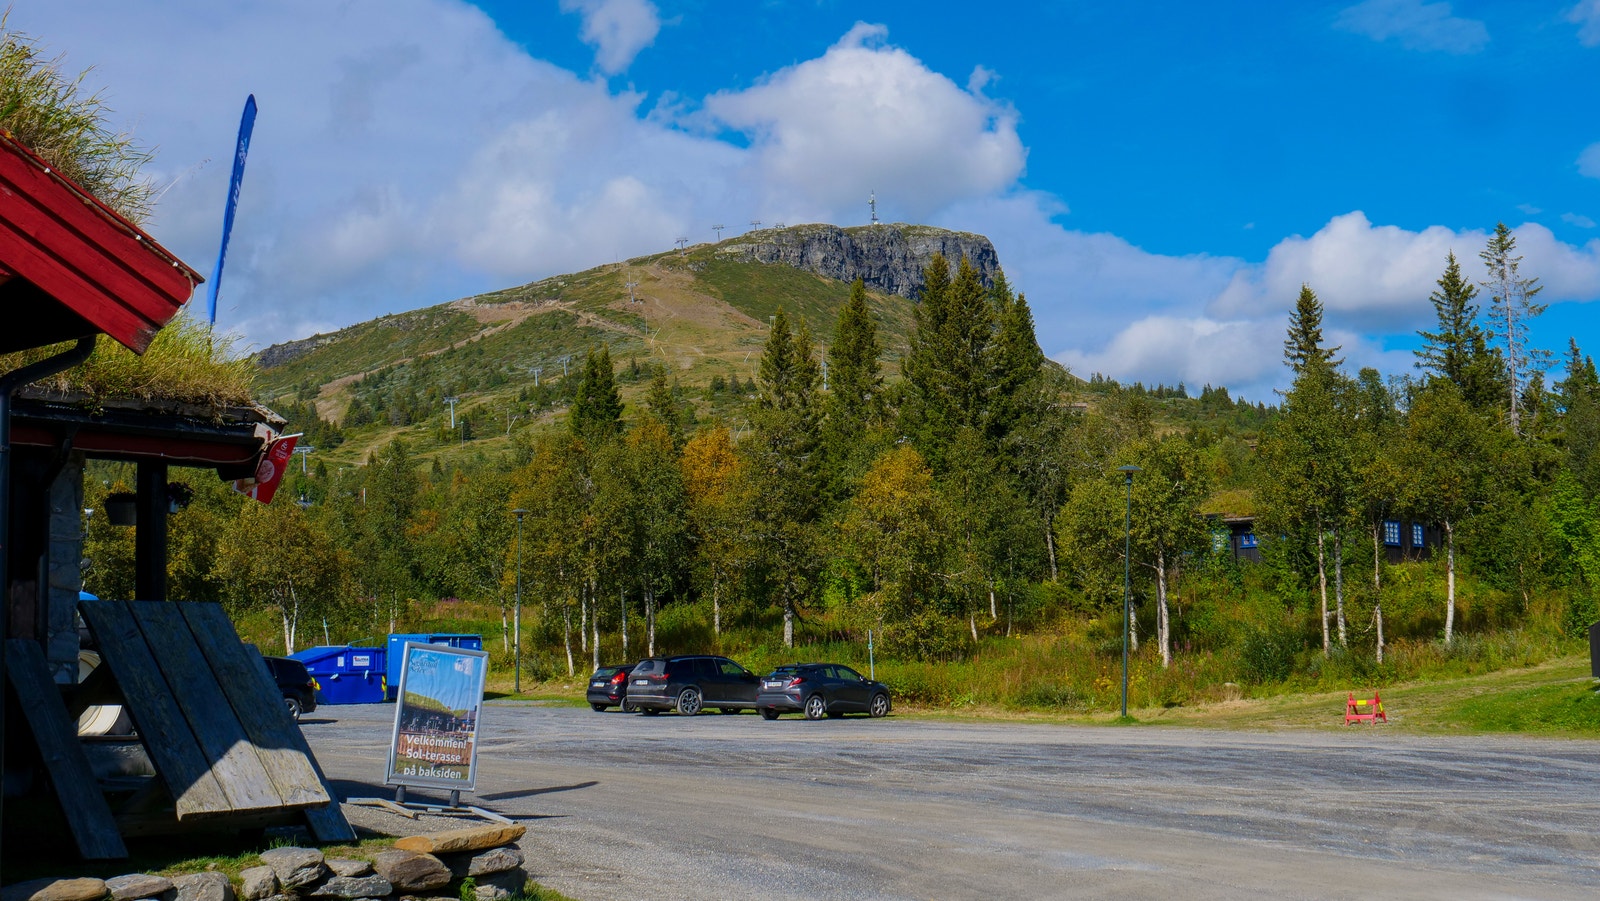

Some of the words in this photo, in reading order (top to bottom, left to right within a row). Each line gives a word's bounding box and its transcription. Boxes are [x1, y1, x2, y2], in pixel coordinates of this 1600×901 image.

[406, 734, 467, 749] Velkommen!
[406, 748, 461, 763] Sol-terasse
[404, 764, 416, 776] på
[418, 765, 462, 779] baksiden
